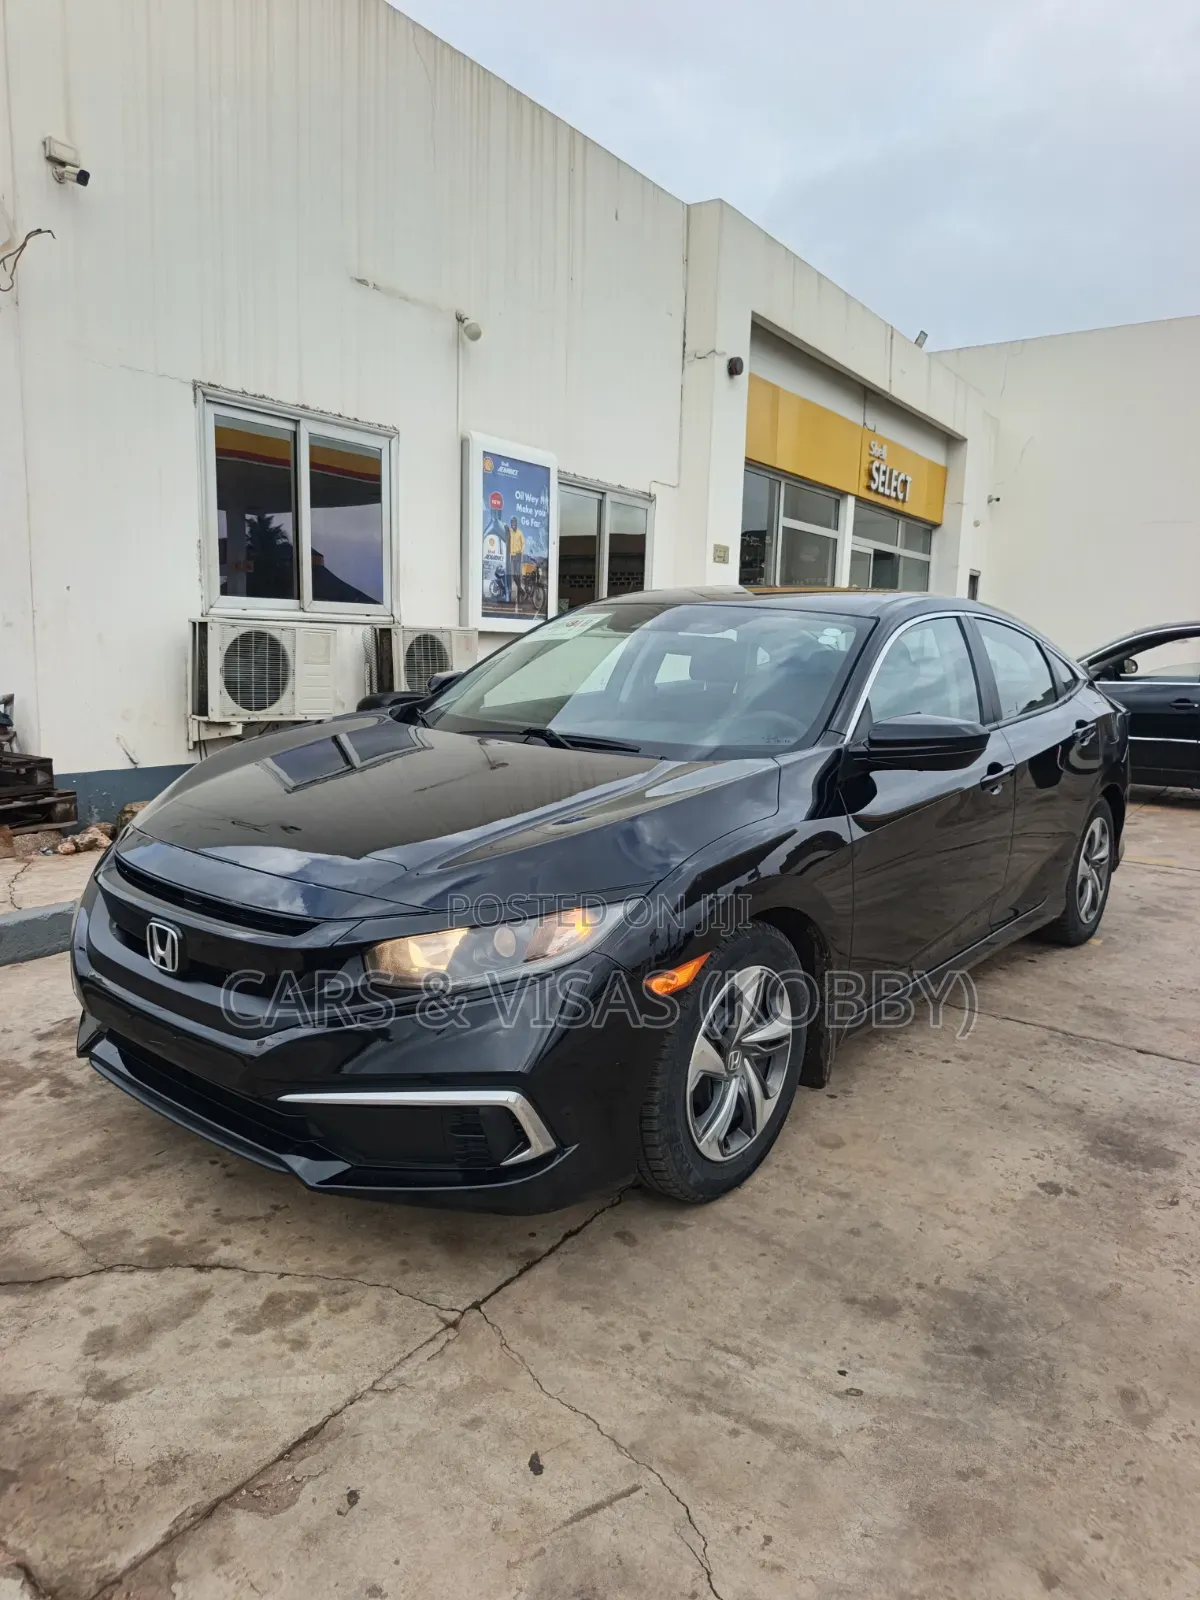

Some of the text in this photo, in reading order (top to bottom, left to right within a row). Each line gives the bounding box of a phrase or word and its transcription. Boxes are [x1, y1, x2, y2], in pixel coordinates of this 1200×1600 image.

[870, 460, 912, 503] SELECT
[514, 490, 524, 501] Oil
[525, 492, 539, 506] Wey
[516, 503, 546, 517] Make you
[521, 516, 541, 528] Go Far
